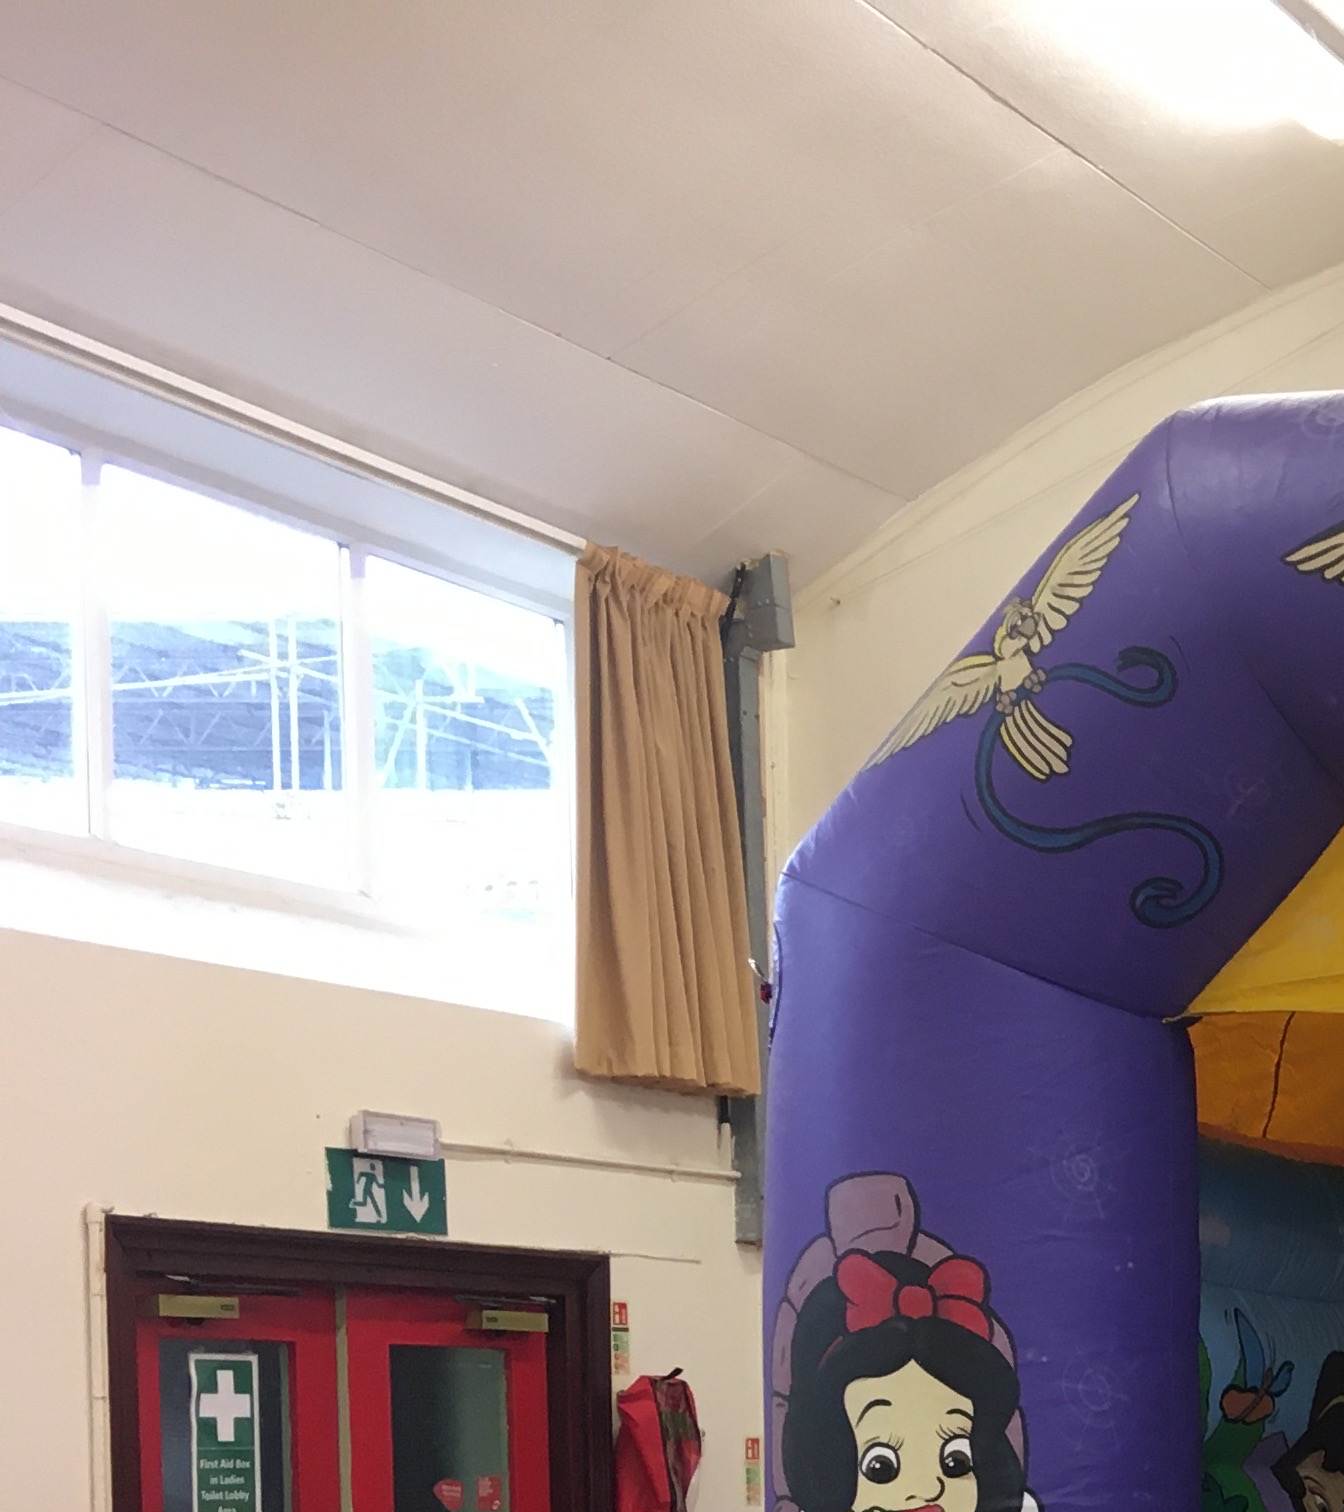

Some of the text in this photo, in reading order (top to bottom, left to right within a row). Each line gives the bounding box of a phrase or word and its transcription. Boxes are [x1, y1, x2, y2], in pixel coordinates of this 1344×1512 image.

[200, 1458, 251, 1469] First Aid Box
